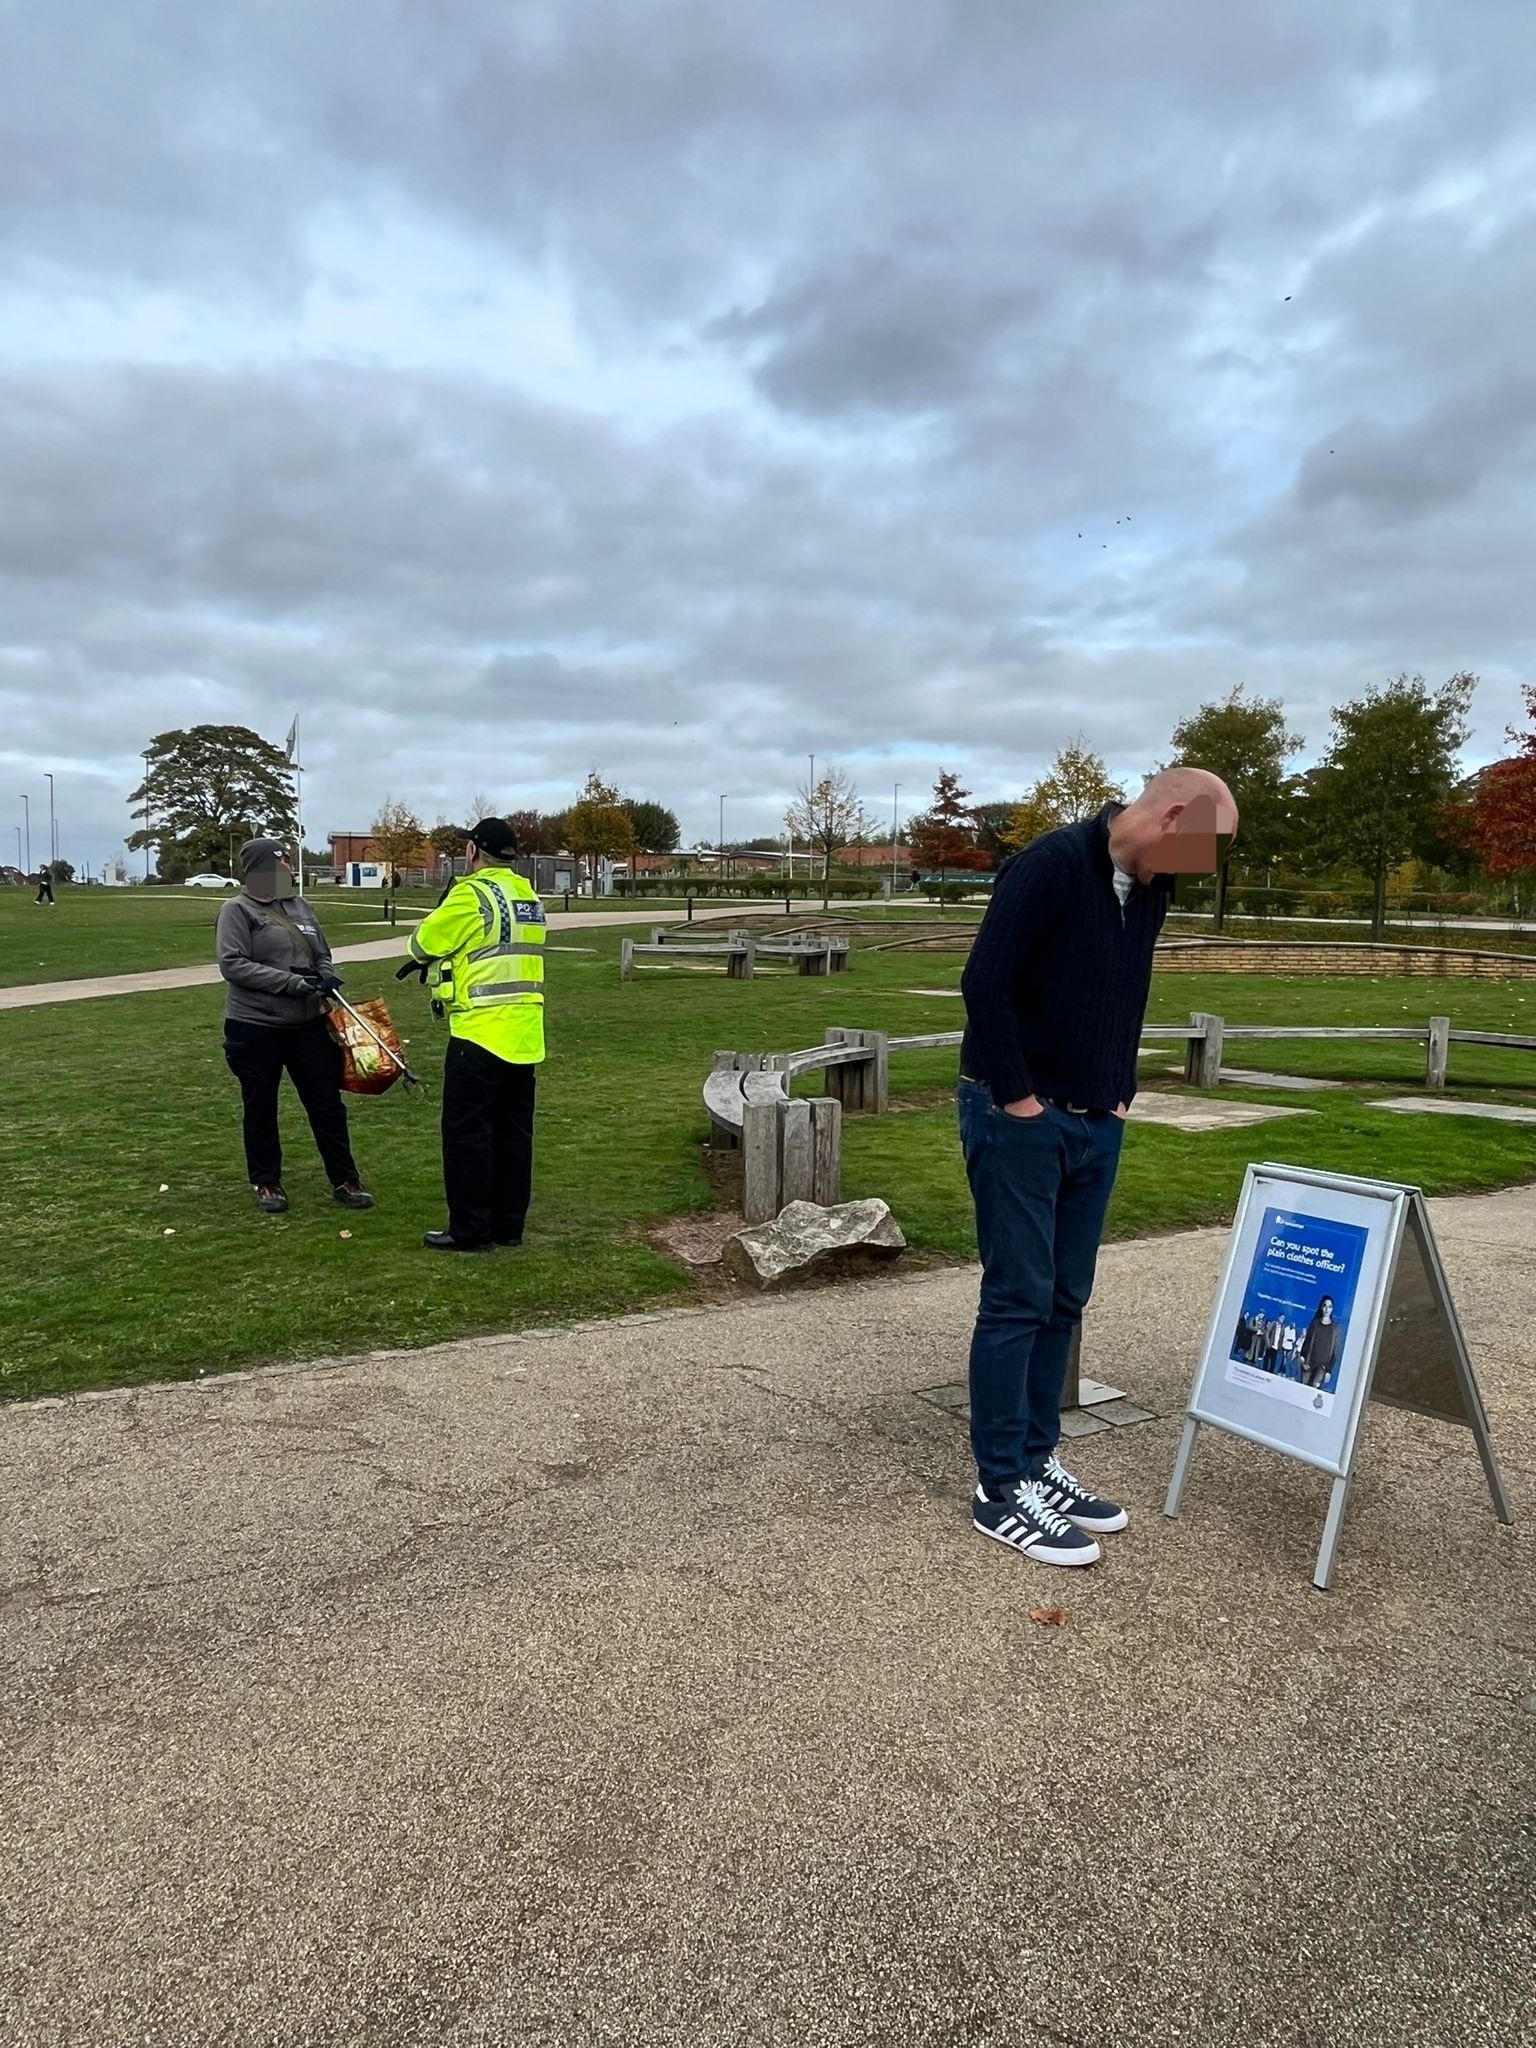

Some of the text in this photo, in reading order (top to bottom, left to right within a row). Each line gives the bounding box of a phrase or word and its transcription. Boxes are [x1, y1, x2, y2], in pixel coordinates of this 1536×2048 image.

[516, 903, 545, 912] POL
[1270, 1236, 1334, 1259] Can you spot the
[1267, 1248, 1285, 1258] plain
[1286, 1252, 1314, 1265] clothes
[1315, 1259, 1345, 1273] officer?
